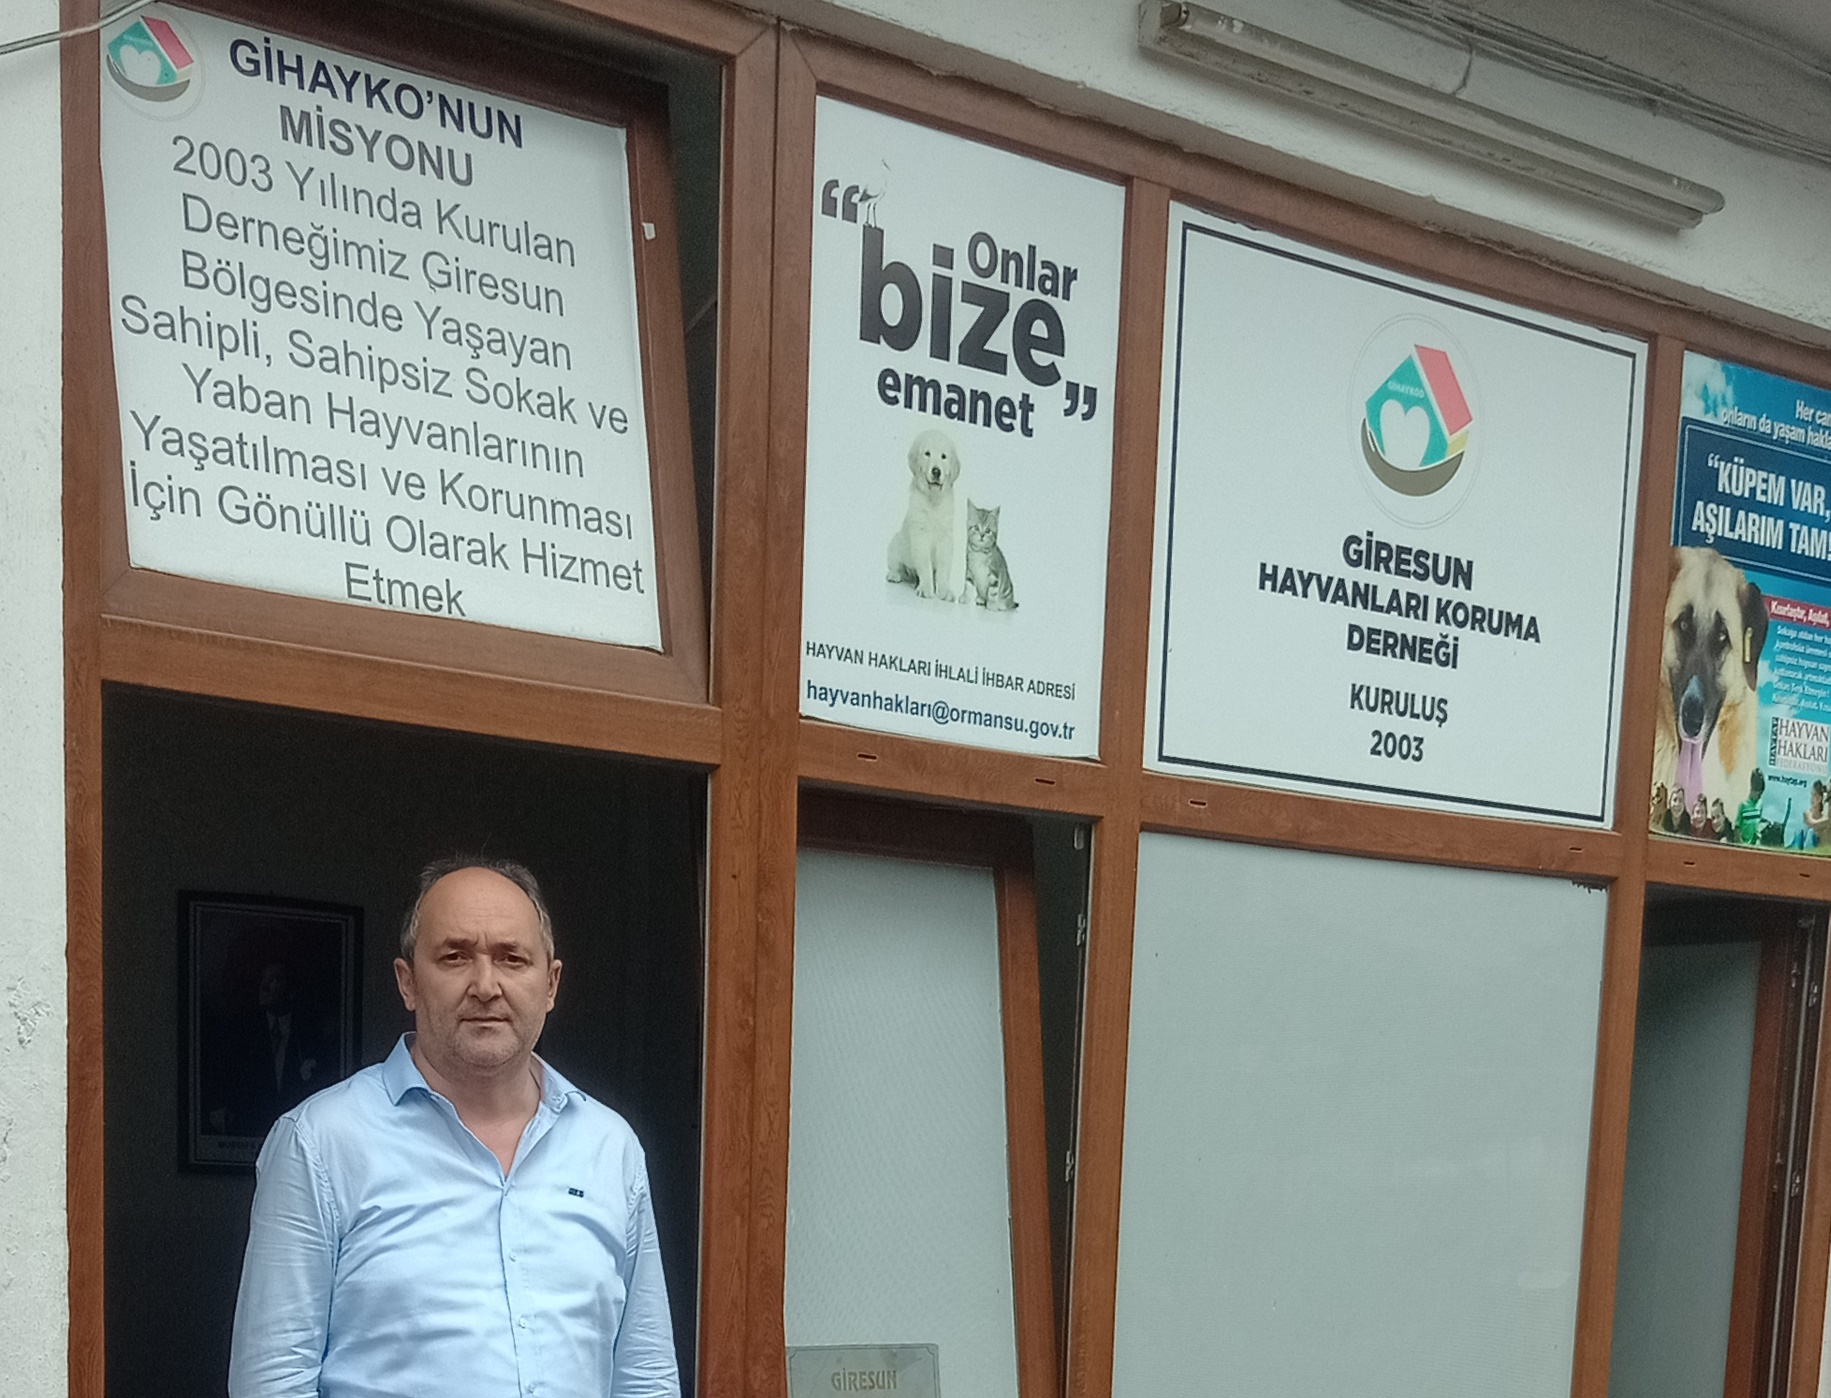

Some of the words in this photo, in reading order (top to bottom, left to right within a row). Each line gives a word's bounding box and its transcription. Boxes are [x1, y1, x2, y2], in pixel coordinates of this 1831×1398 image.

[228, 36, 524, 149] GİHAYKO'NUN
[279, 105, 474, 187] MİSYONU
[171, 136, 274, 192] 2003
[285, 159, 422, 230] Yılında
[436, 198, 577, 267] Kurulan
[181, 191, 410, 280] Derneğimiz
[422, 252, 565, 317] Giresun
[968, 231, 1078, 301] Onlar
[181, 249, 403, 334] Bölgesinde
[413, 300, 572, 371] Yaşayan
[859, 223, 1065, 387] bize
[120, 294, 272, 366] Sahipli,
[289, 330, 454, 398] Sahipsiz
[465, 367, 577, 424] Sokak
[588, 402, 629, 435] ve
[181, 362, 312, 425] Yaban
[327, 393, 585, 478] Hayvanlarının
[877, 367, 1034, 438] emanet
[1759, 413, 1771, 434] da
[1773, 421, 1805, 444] yaşam
[1796, 399, 1814, 421] Her
[130, 410, 367, 491] Yaşatılması
[381, 465, 425, 500] ve
[439, 471, 632, 540] Korunması
[1708, 453, 1786, 507] “KÜPEM
[1791, 479, 1831, 523] VAR,
[128, 460, 201, 519] İçin
[217, 484, 372, 547] Gönüllü
[385, 514, 509, 570] Olarak
[522, 537, 645, 594] Hizmet
[1692, 500, 1784, 550] AŞILARIM
[344, 562, 467, 617] Etmek
[1342, 531, 1473, 592] GİRESUN
[1258, 562, 1429, 622] HAYVANLARI
[1435, 598, 1541, 643] KORUMA
[806, 641, 864, 665] HAYVAN
[868, 651, 931, 676] HAKLARI
[935, 659, 978, 684] İHLALİ
[982, 667, 1023, 692] İHBAR
[1027, 679, 1075, 700] ADRESİ
[1347, 624, 1459, 669] DERNEĞİ
[807, 680, 1075, 740] hayvanhakları@ormansu.gov.tr
[1350, 683, 1448, 728] KURULUŞ
[1779, 718, 1829, 742] HAYVAN
[1370, 729, 1424, 763] 2003
[1778, 740, 1827, 762] HAKLARI
[831, 1367, 897, 1392] GİRESUN
